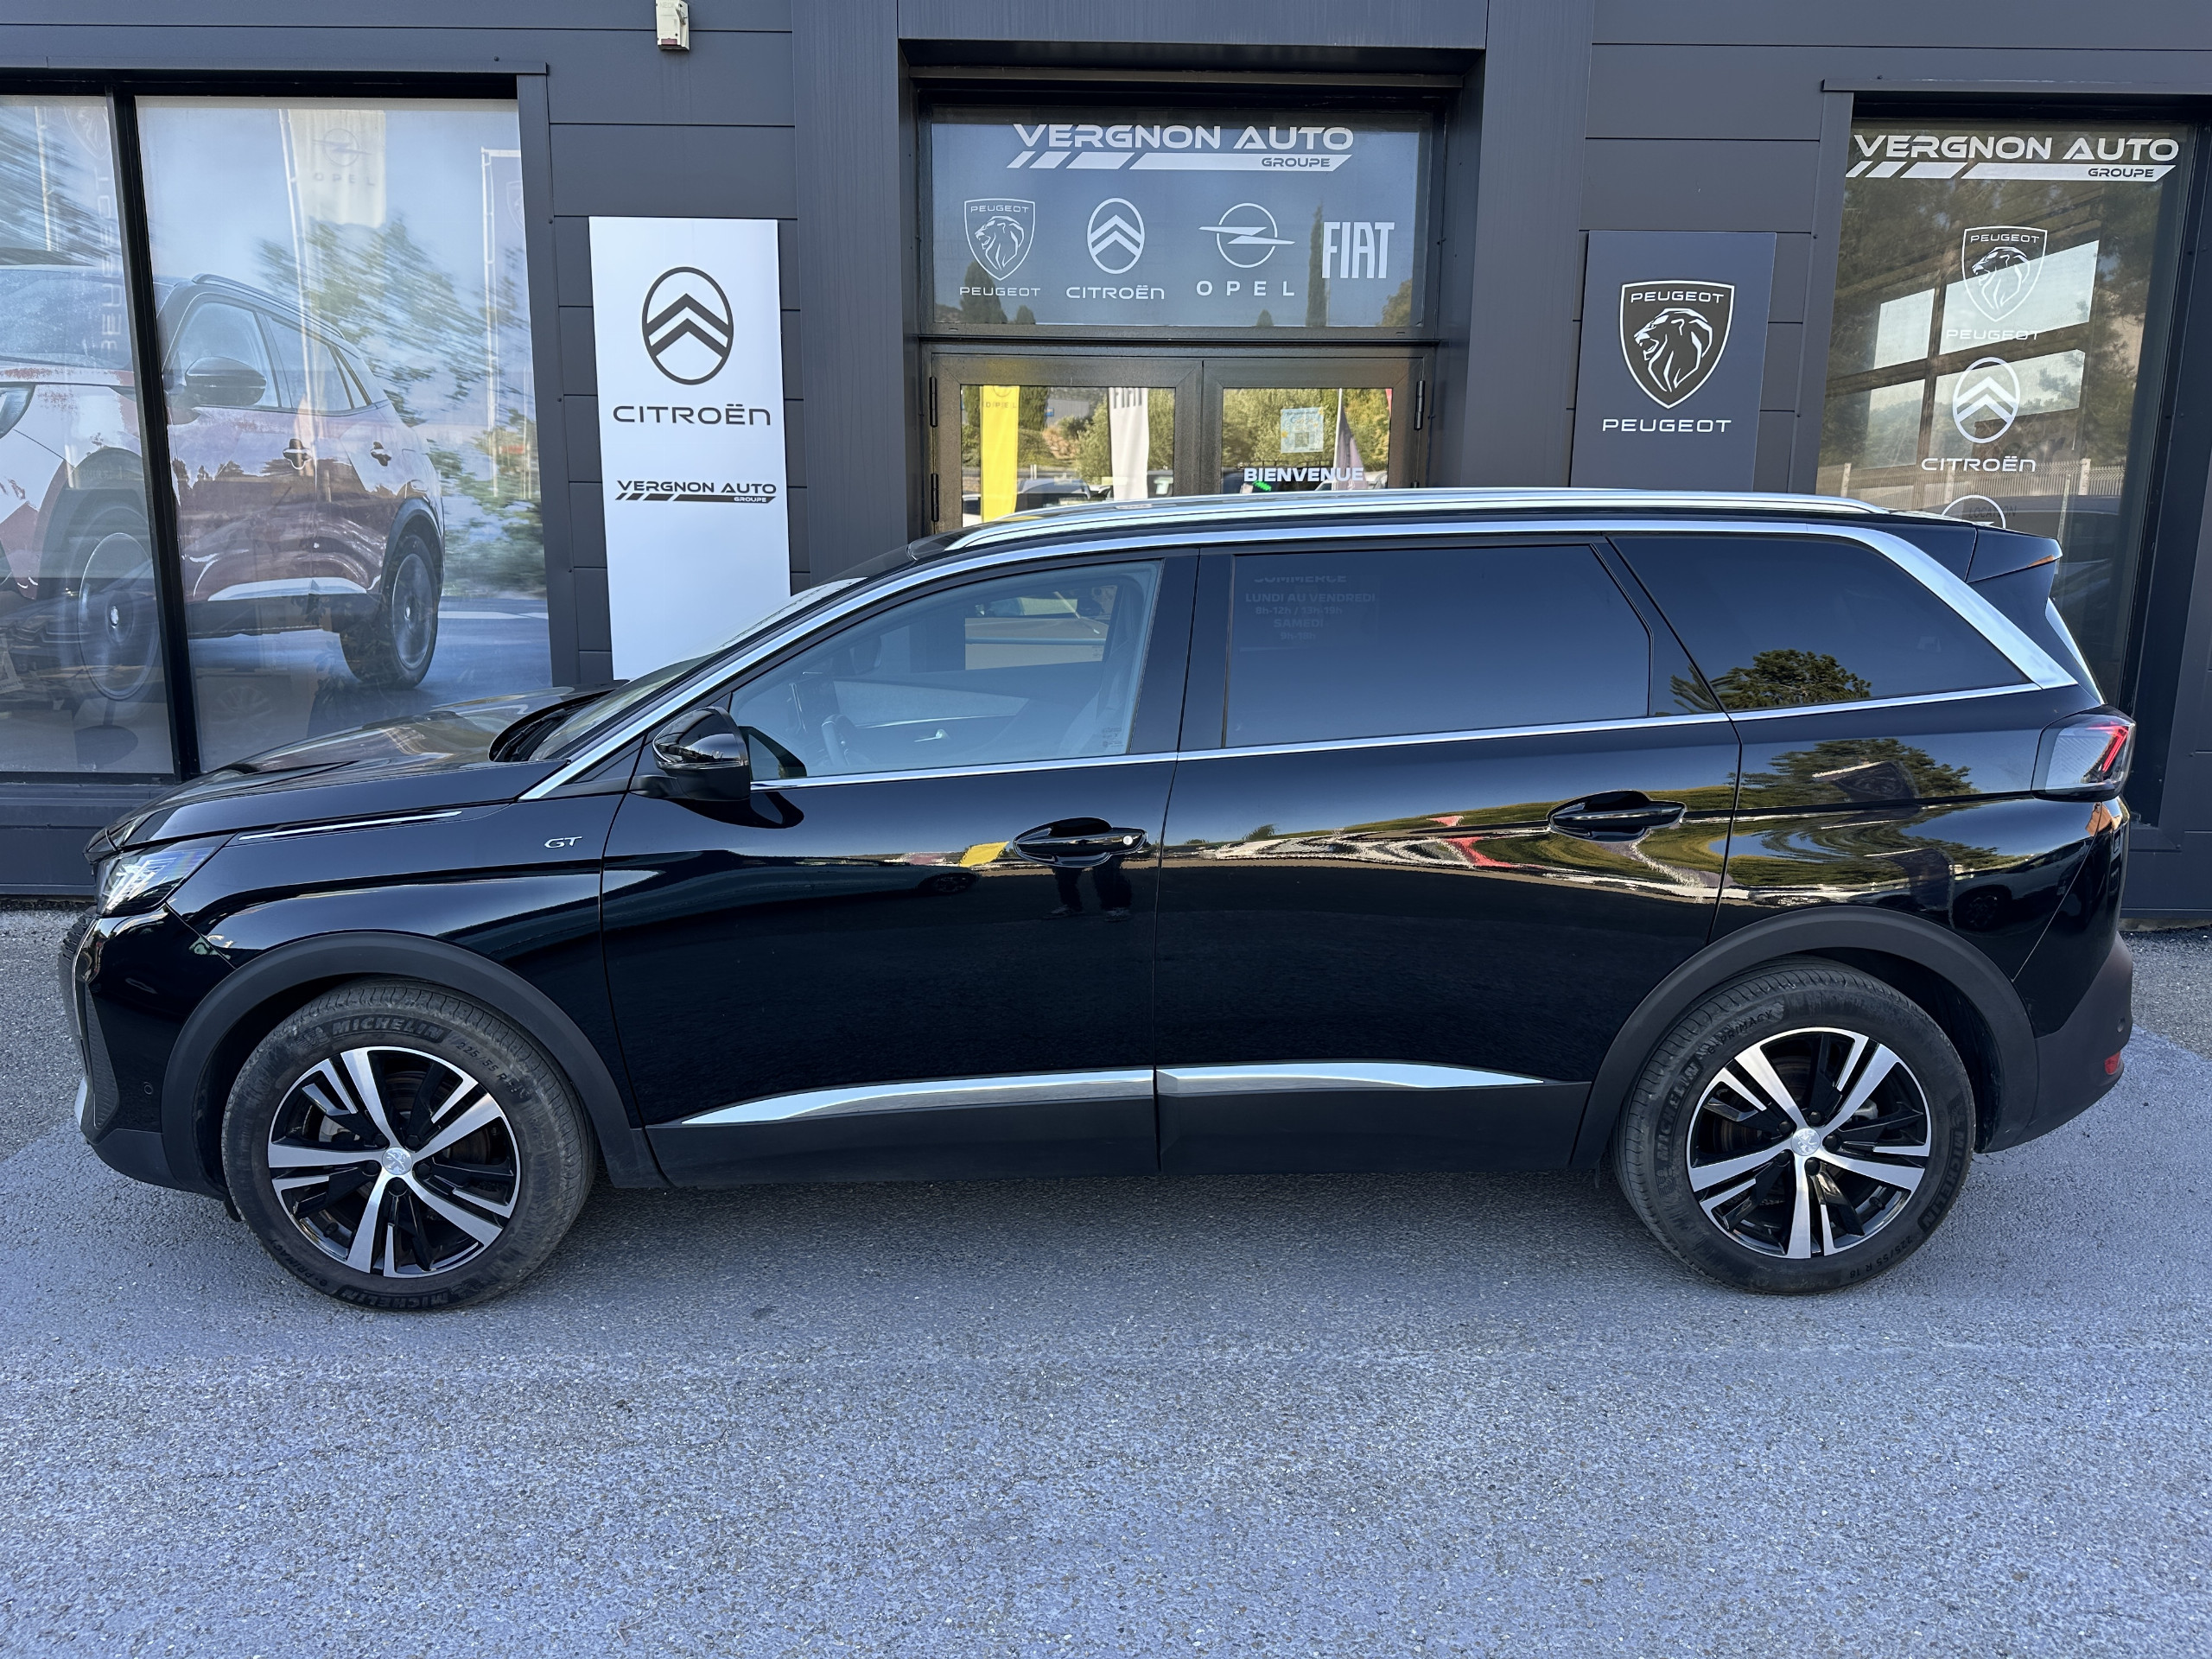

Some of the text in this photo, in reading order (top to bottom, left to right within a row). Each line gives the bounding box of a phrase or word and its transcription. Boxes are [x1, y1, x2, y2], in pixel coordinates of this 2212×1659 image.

[1013, 123, 1355, 150] VERGNON AUTO
[1853, 135, 2179, 162] VERGNON AUTO
[1261, 157, 1331, 168] GROUPE
[2088, 168, 2155, 178] GROUPE
[970, 205, 1030, 213] PEUGEOT
[1969, 233, 2040, 244] PEUGEOT
[1321, 221, 1395, 279] FIAT
[959, 286, 1041, 297] PEUGEOT
[1196, 280, 1296, 296] OPEL
[1630, 290, 1725, 303] PEUGEOT
[1945, 329, 2038, 340] PEUGEOT
[1602, 418, 1732, 433] PEUGEOT
[1243, 467, 1364, 482] BIENVENUE
[617, 480, 777, 494] VERGNON AUTO
[1968, 505, 2018, 518] LOCATON
[1245, 593, 1376, 602] LUNDI AU VENDREDI
[1273, 619, 1324, 628] SAMEDI
[543, 836, 583, 849] GT
[332, 1015, 446, 1039] MICHELIN
[1656, 1061, 1701, 1161] MICHELIN
[1923, 1129, 1966, 1227] MICHELIN
[340, 1286, 449, 1310] MICHELIN
